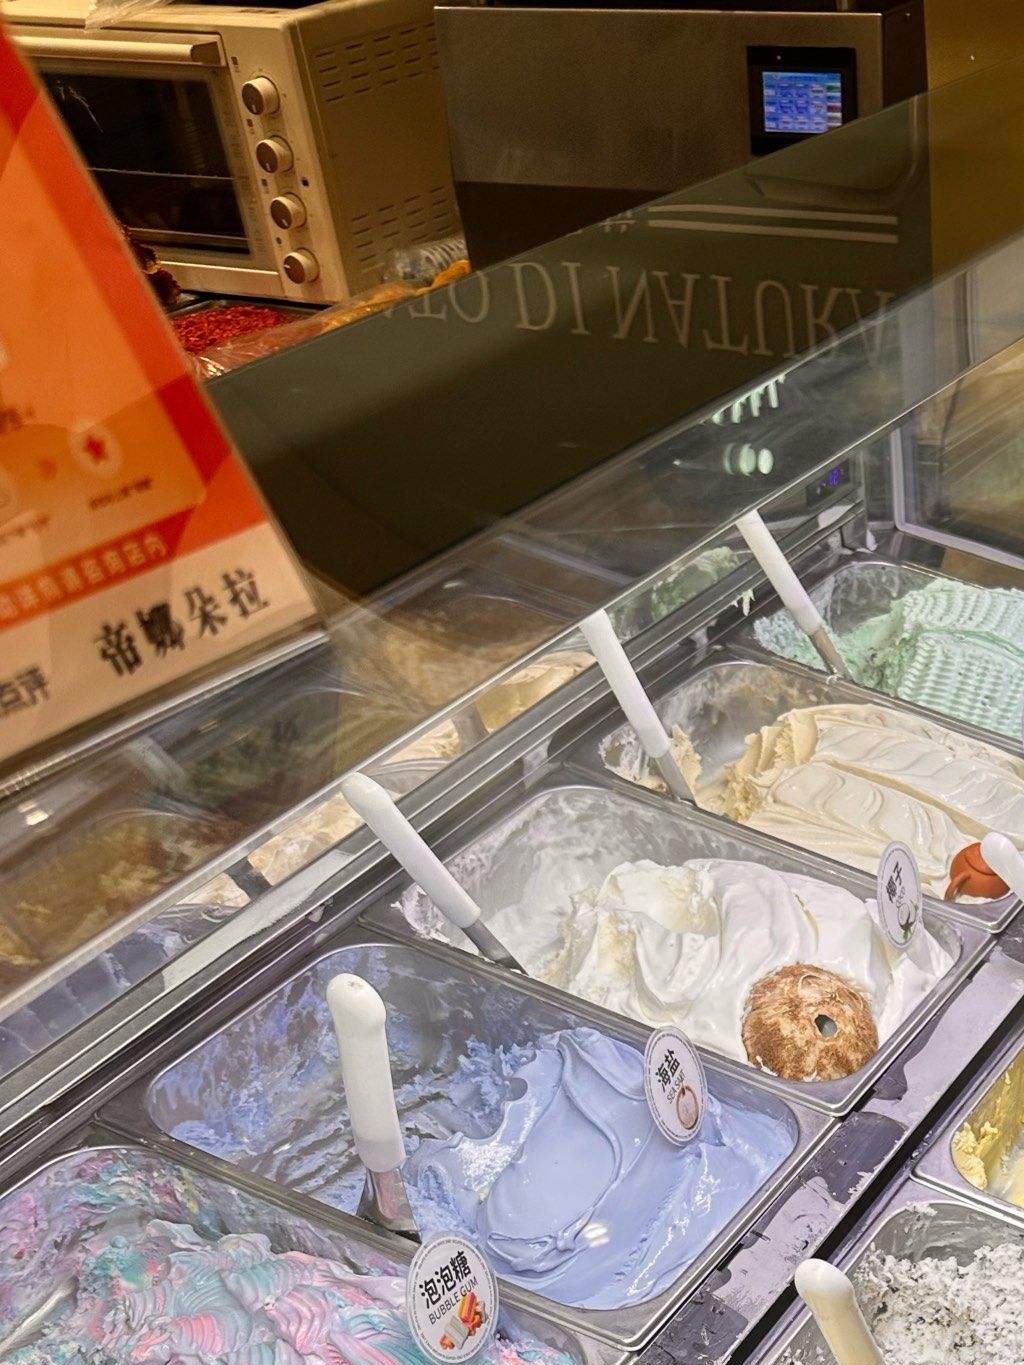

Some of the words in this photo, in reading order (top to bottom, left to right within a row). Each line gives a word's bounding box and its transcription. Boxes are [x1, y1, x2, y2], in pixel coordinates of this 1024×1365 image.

[655, 1049, 681, 1093] 海盐
[419, 1250, 472, 1309] 泡泡糖
[428, 1291, 461, 1325] BUBBLE
[460, 1276, 479, 1297] GUM
